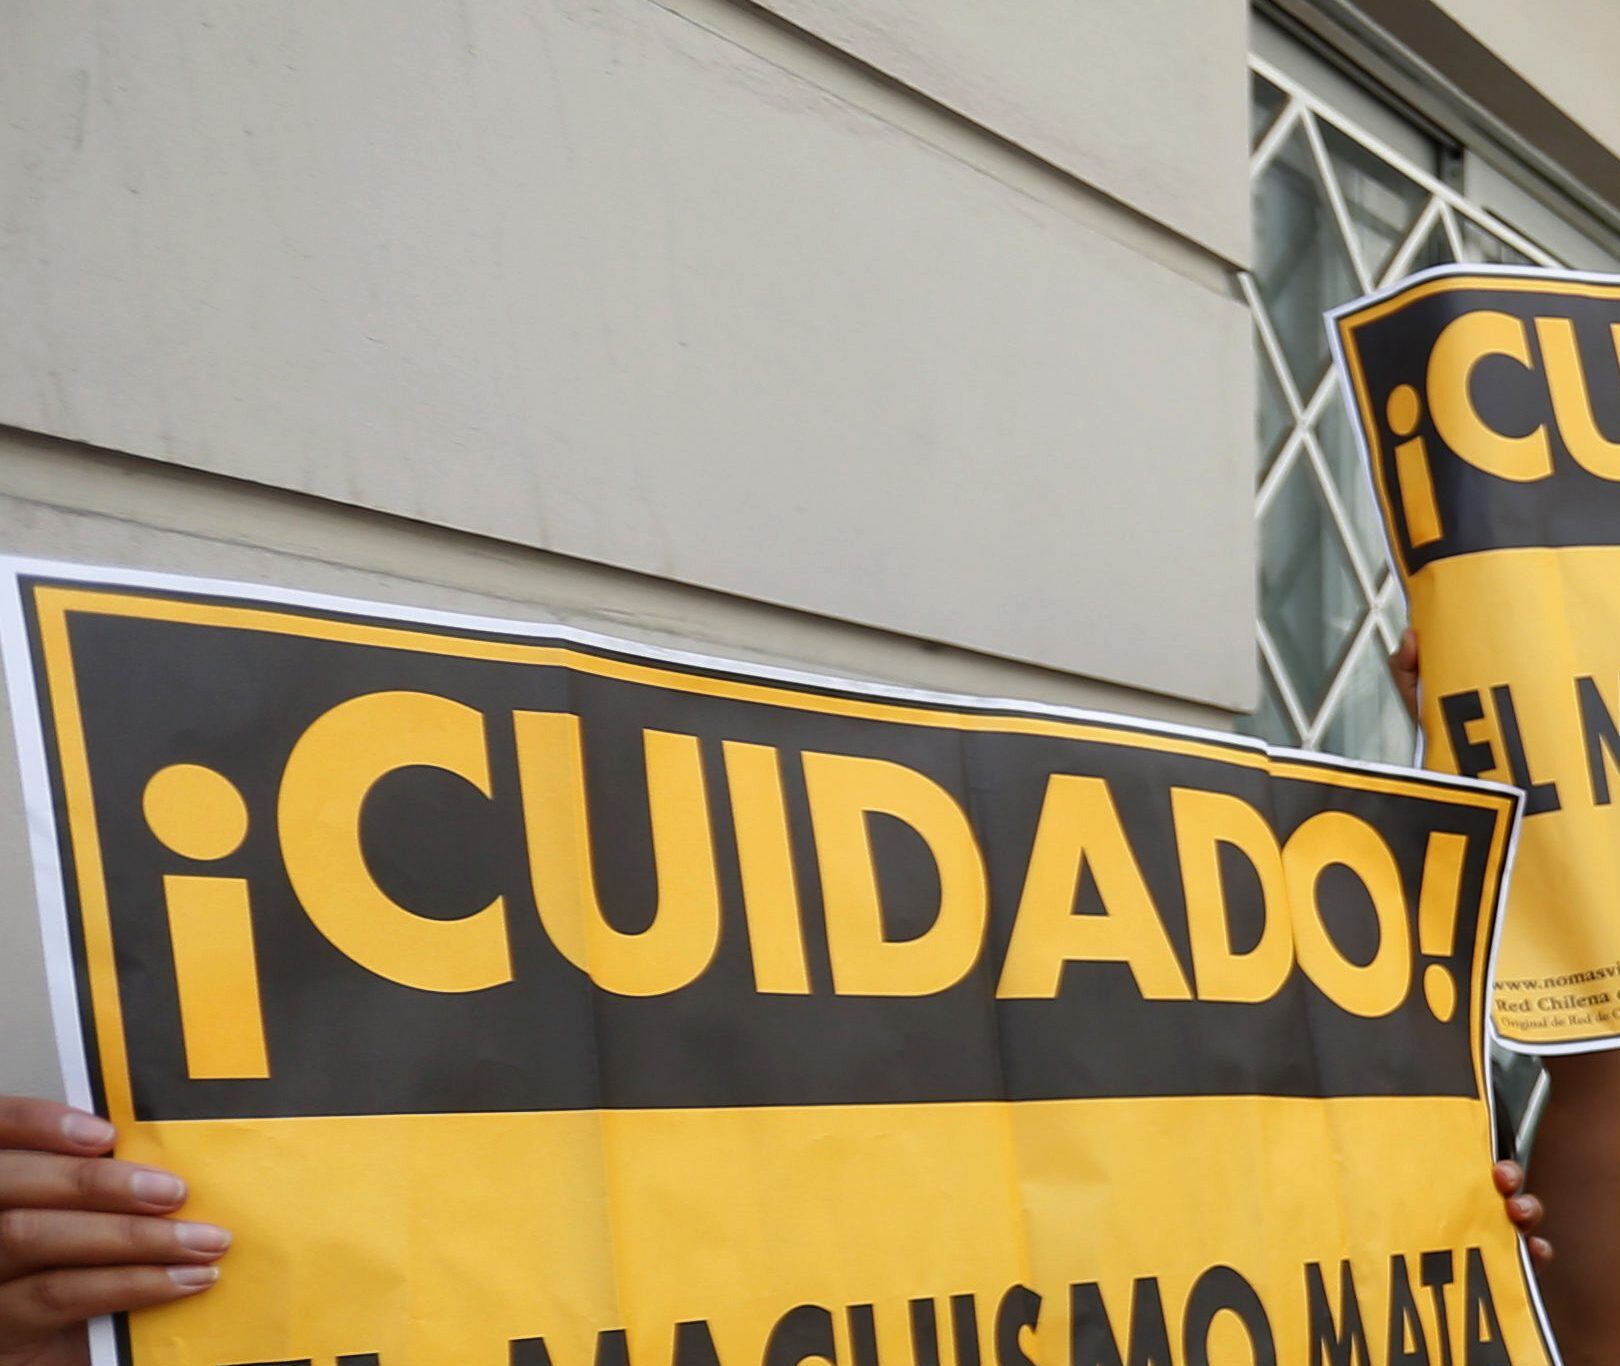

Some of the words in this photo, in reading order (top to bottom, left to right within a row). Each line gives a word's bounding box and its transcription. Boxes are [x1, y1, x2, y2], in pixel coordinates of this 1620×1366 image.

[1438, 683, 1562, 818] EL
[140, 689, 1471, 1081] ¡CUIDADO!
[1495, 998, 1531, 1014] Red
[1537, 993, 1610, 1013] Chilena
[1551, 1014, 1564, 1027] de
[1568, 1012, 1592, 1026] Red
[1596, 1010, 1610, 1022] de
